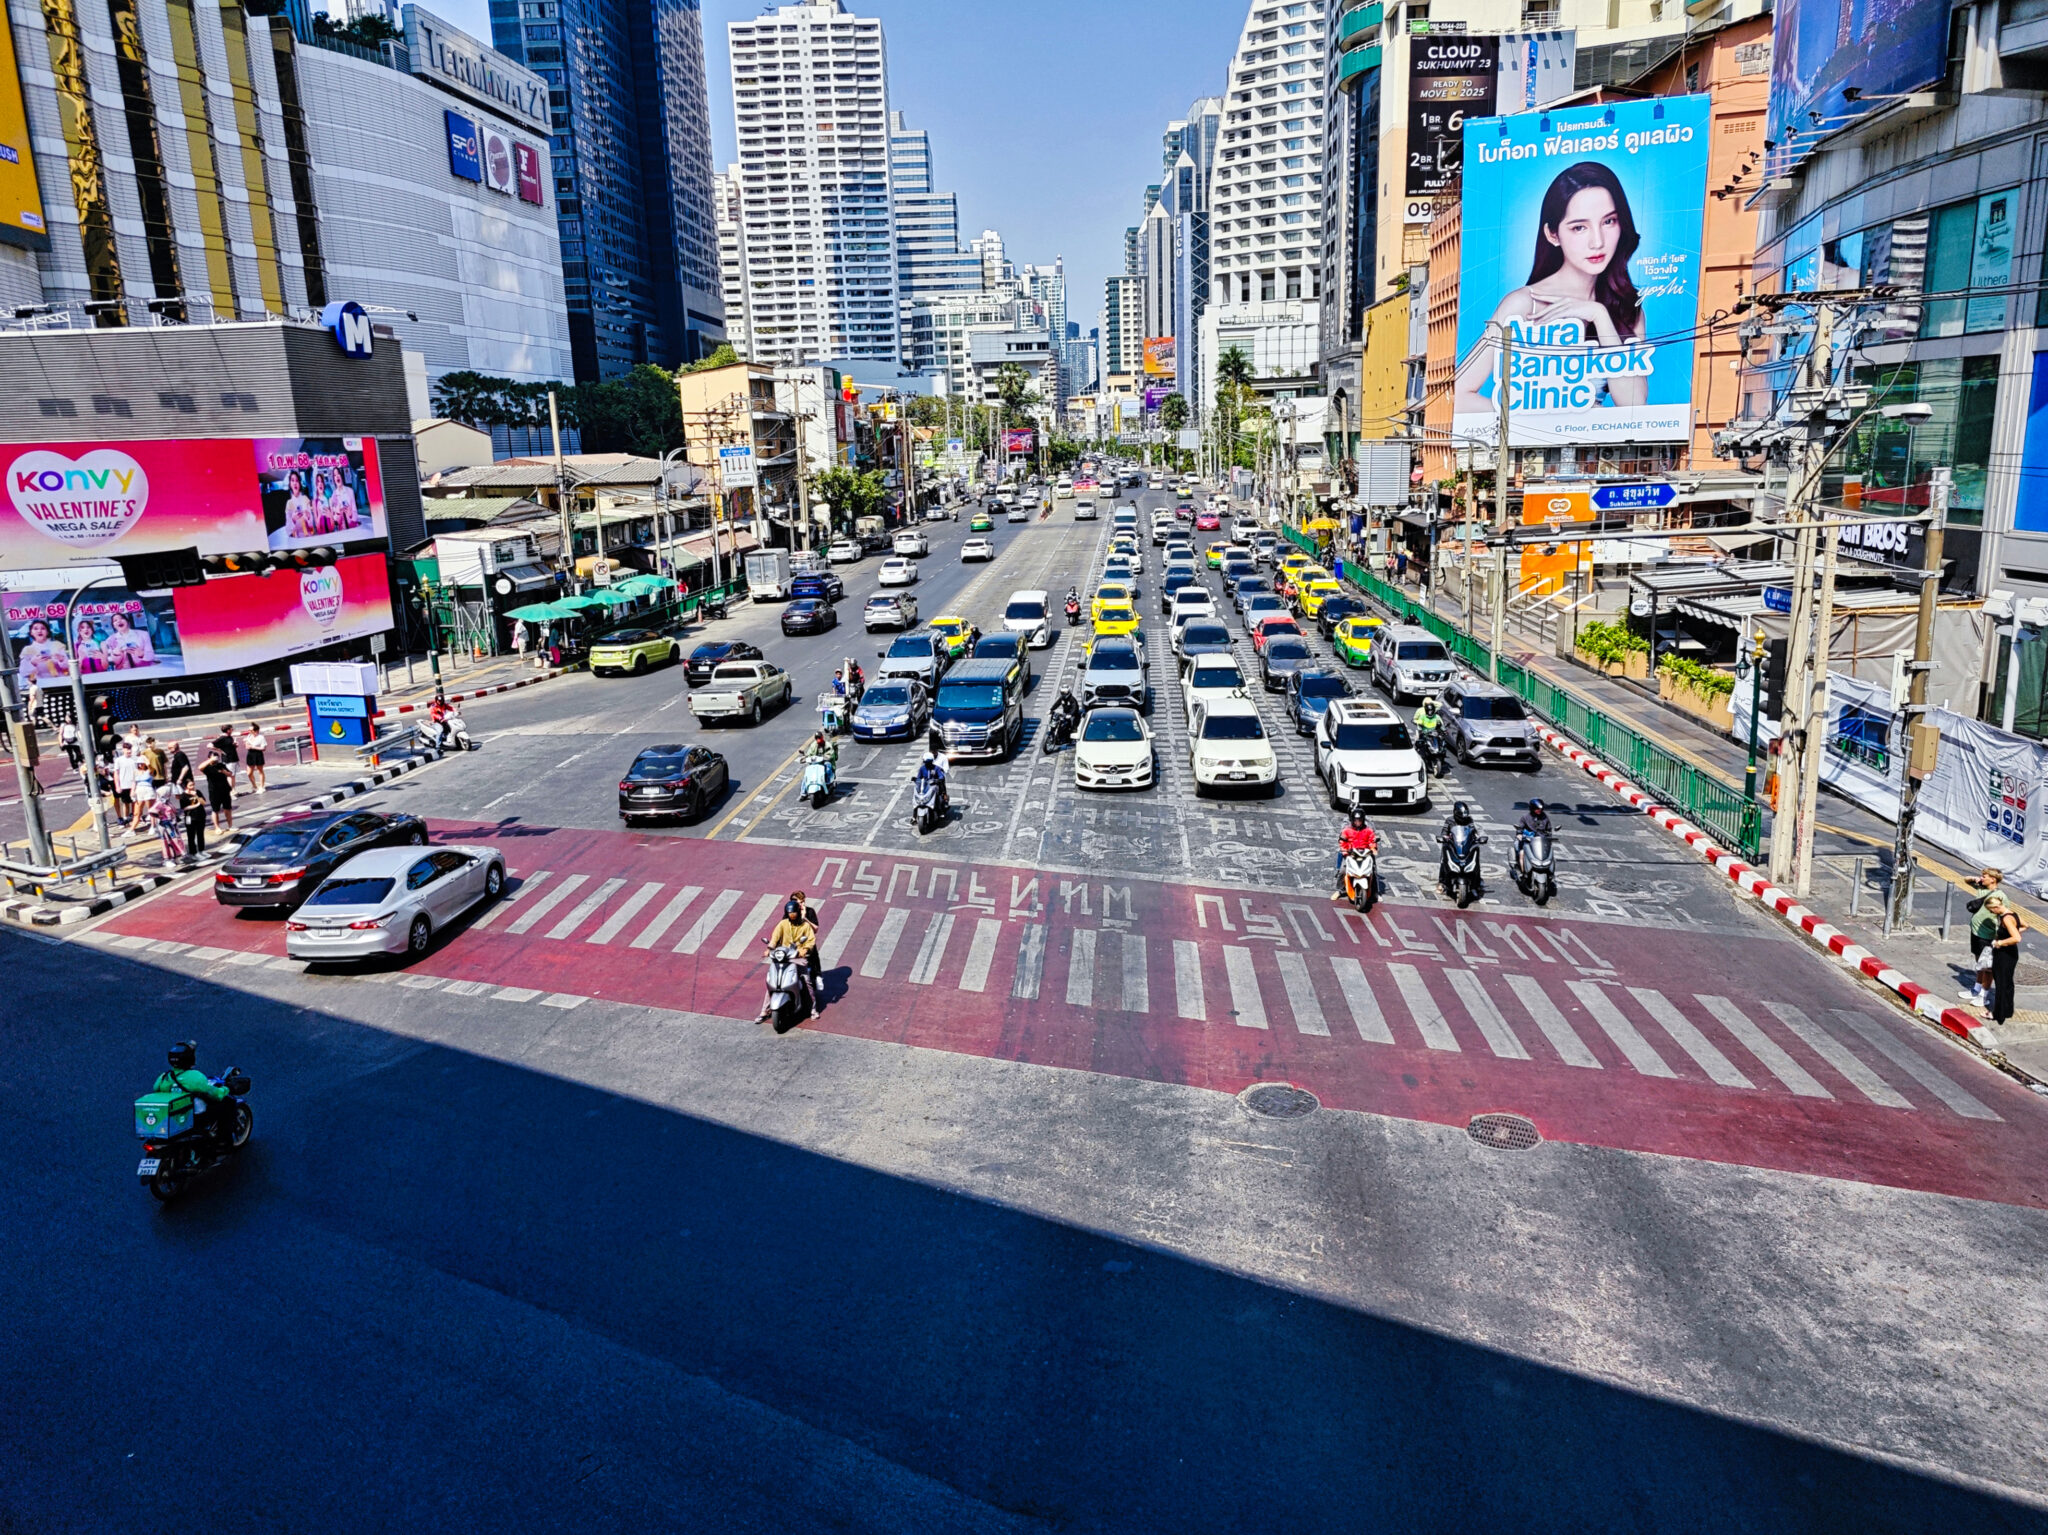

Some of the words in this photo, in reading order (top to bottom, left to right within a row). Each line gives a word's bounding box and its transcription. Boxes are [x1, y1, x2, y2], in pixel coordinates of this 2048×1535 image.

[1427, 44, 1482, 59] CLOUD
[1416, 59, 1477, 70] SUKHUMVIT
[1478, 58, 1492, 69] 23
[420, 20, 529, 115] TERMINAL
[526, 79, 551, 125] 21
[1432, 80, 1460, 88] READY
[1420, 89, 1448, 98] MOVE
[1428, 115, 1443, 124] BR.
[1477, 138, 1538, 164] โบท็อก
[1543, 128, 1620, 157] ฟิลเลอร์
[1624, 123, 1694, 155] ดูแลผิว
[1420, 155, 1435, 164] BR.
[1424, 180, 1447, 188] FULLY
[342, 312, 373, 354] M
[1509, 319, 1580, 348] Aura
[1500, 343, 1649, 385] Bangkok
[1499, 378, 1591, 411] Clinic
[1555, 425, 1563, 433] G
[1564, 424, 1590, 433] Floor,
[1591, 421, 1643, 431] EXCHANGE
[1645, 420, 1680, 430] TOWER
[298, 452, 310, 469] 68
[1622, 486, 1661, 501] สุขุมวิท
[26, 499, 137, 521] VALENTINE'S
[1609, 500, 1642, 508] Sukhumvit
[46, 522, 88, 533] MEGA
[90, 520, 125, 532] SALE
[1863, 522, 1909, 555] BROS.
[1853, 548, 1886, 563] DOUGHNUTS
[46, 604, 67, 616] 68
[79, 604, 95, 615] 14
[125, 600, 142, 612] 68
